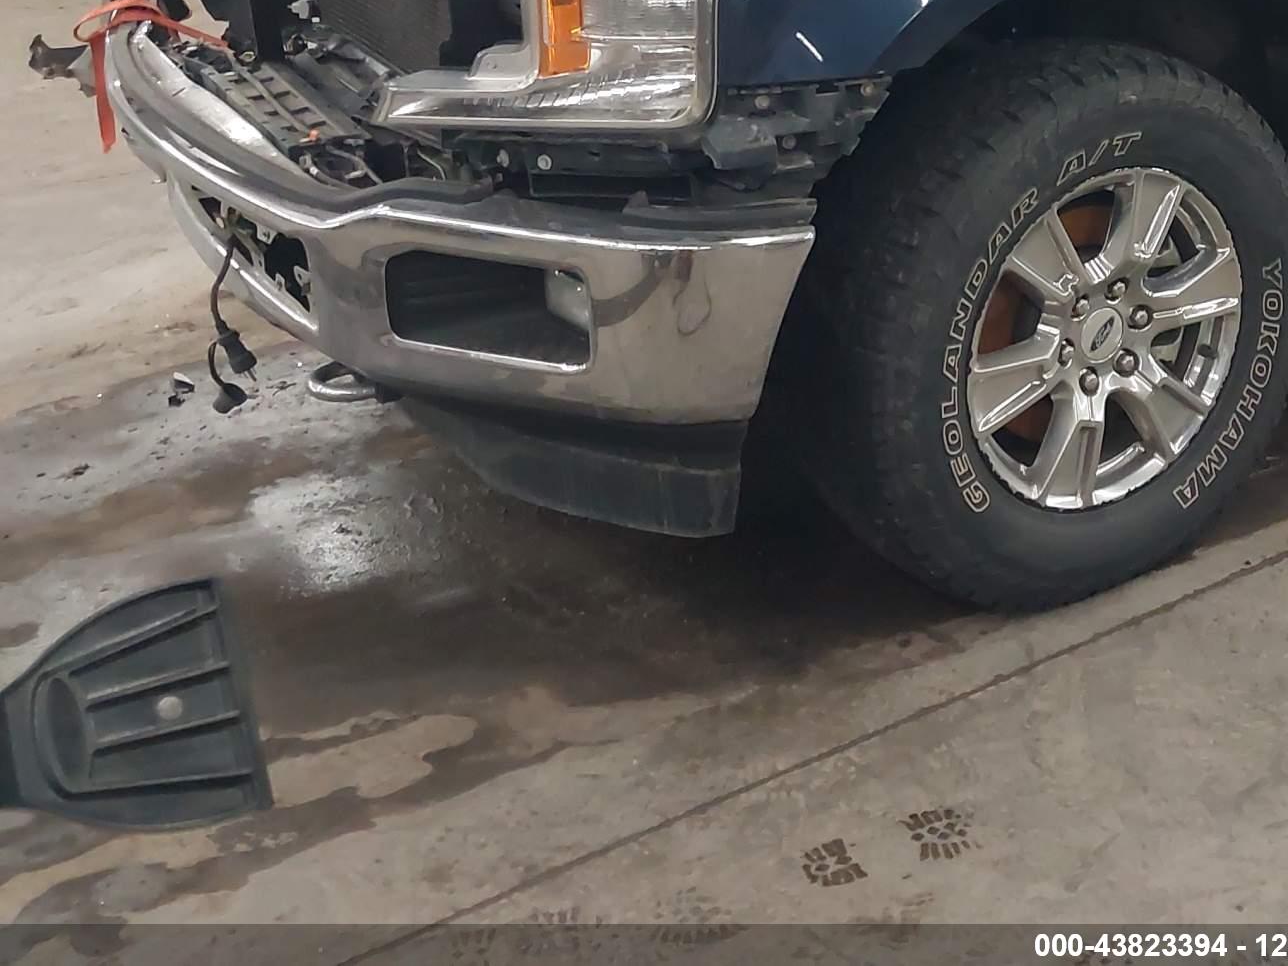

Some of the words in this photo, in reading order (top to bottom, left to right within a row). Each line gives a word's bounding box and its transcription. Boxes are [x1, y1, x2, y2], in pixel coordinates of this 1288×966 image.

[941, 187, 1039, 514] GEOLANDAR
[1056, 131, 1142, 183] A/T
[1173, 257, 1284, 510] YOKOHAMA
